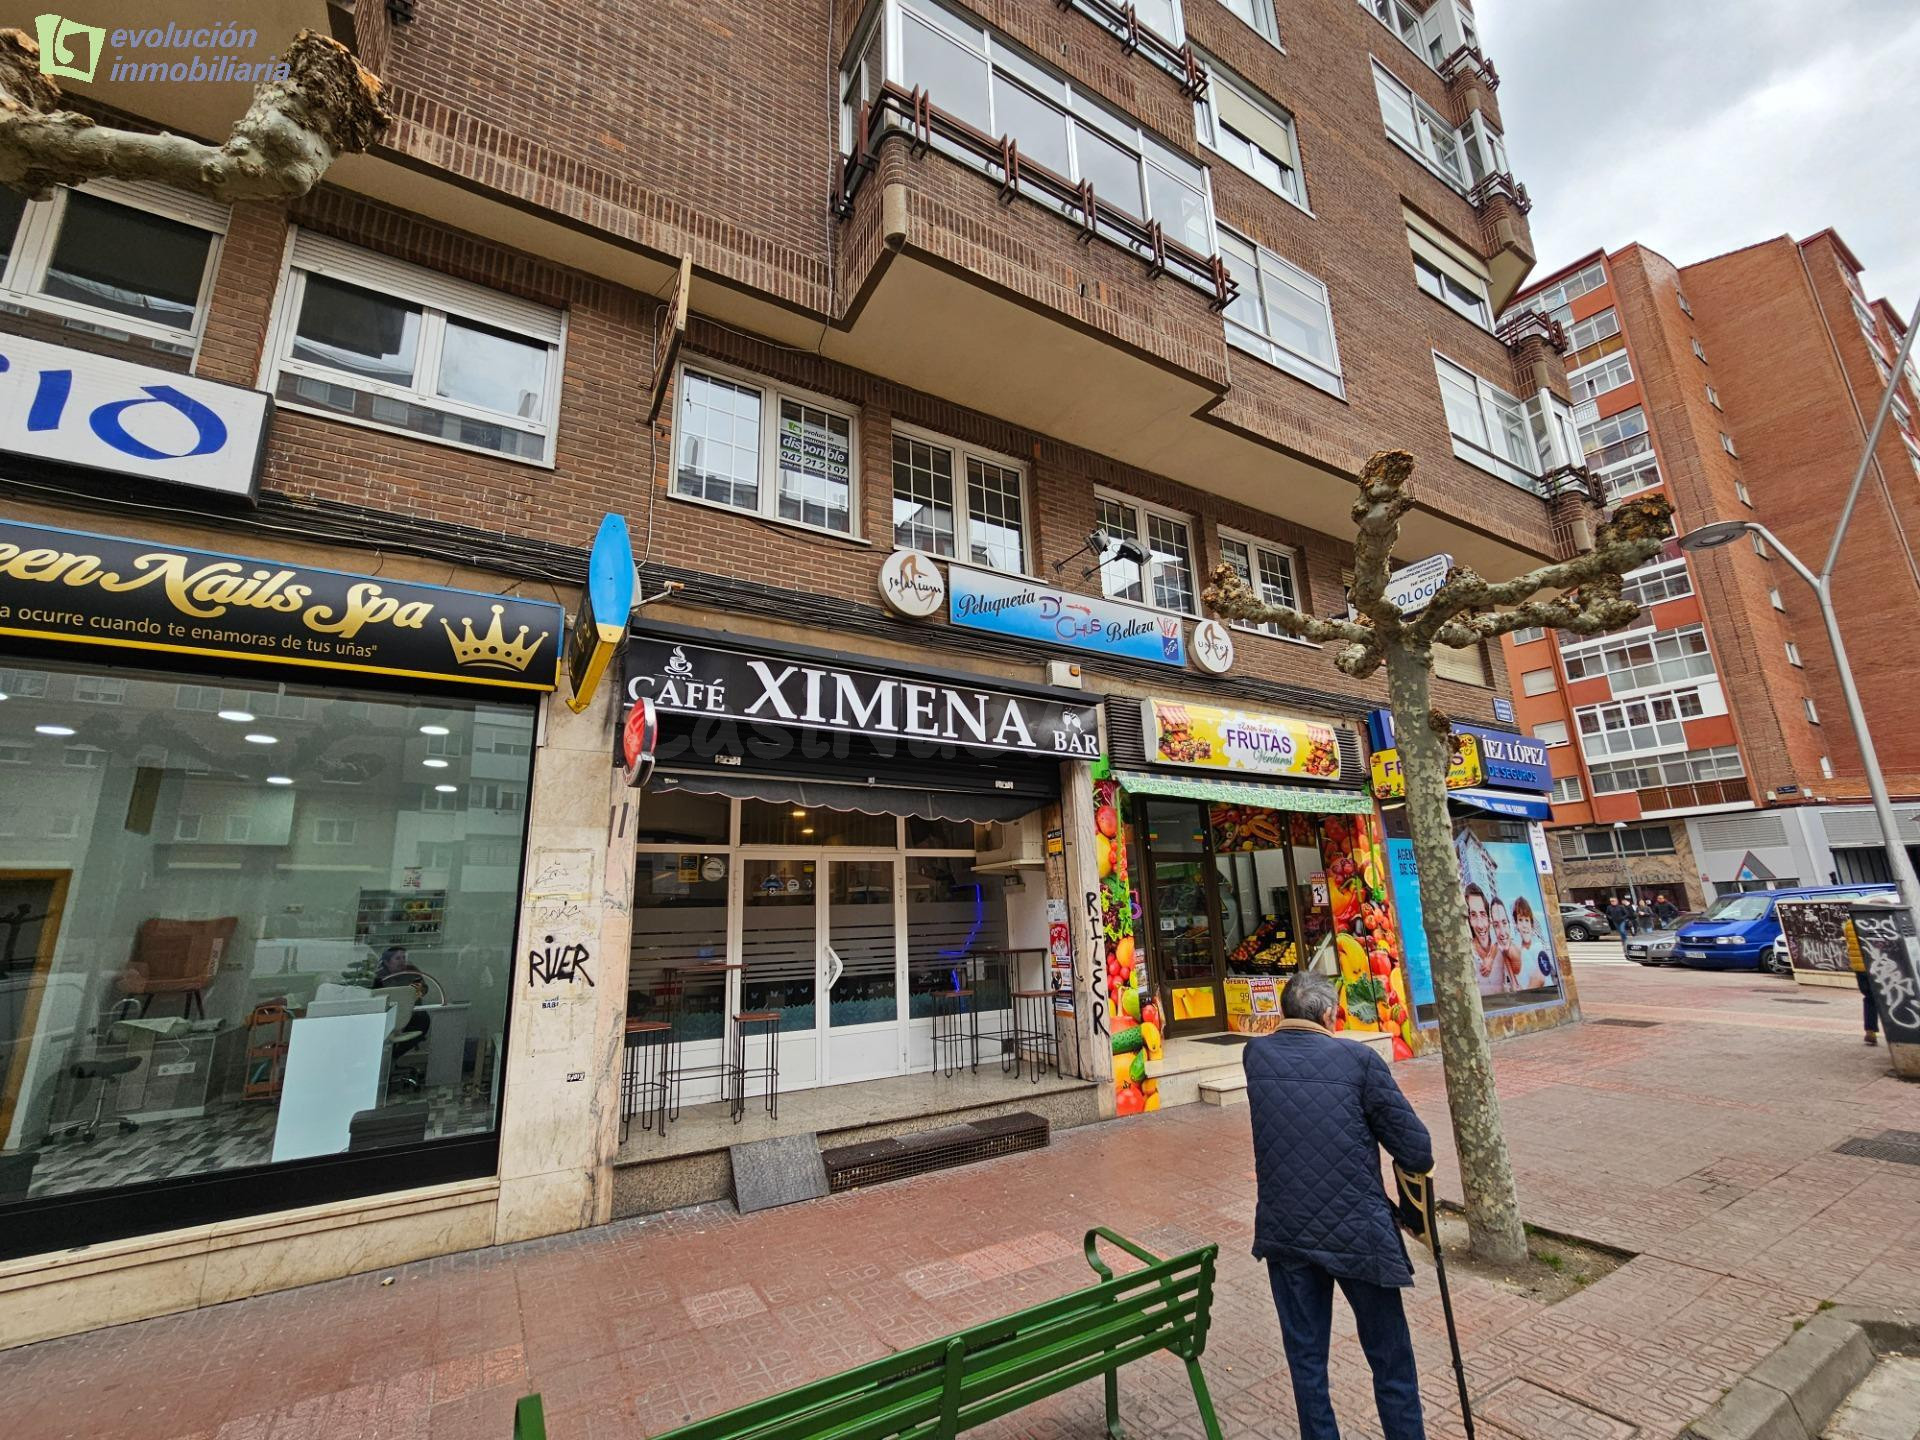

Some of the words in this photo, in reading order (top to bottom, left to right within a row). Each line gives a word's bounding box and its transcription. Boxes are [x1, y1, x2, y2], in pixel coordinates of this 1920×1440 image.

[100, 553, 312, 618] Nails
[303, 583, 434, 639] Spa
[18, 607, 84, 627] ocurre
[90, 614, 161, 635] cuando
[167, 622, 185, 638] te
[191, 627, 276, 648] enamoras
[281, 634, 301, 650] de
[306, 638, 331, 653] tus
[1106, 619, 1154, 642] Belleza
[628, 676, 726, 712] CAFÉ
[744, 660, 1037, 748] XIMENA
[1053, 729, 1100, 756] BAR
[1226, 729, 1292, 754] FRUTAS
[1505, 740, 1547, 766] LÓPEZ
